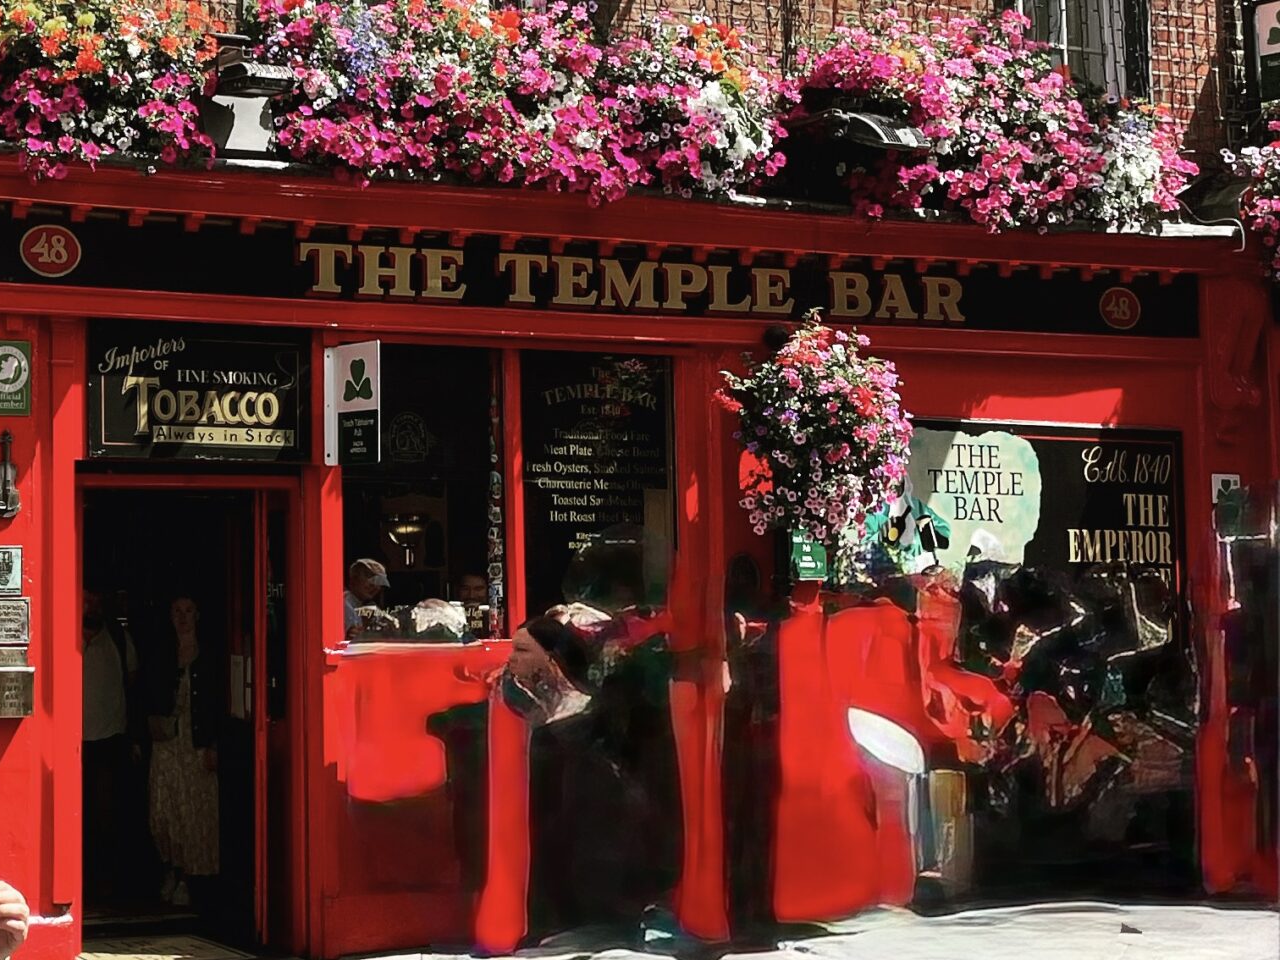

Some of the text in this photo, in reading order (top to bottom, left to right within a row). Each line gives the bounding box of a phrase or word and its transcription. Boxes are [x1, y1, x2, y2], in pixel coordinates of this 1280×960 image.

[30, 232, 68, 264] 48
[298, 241, 966, 323] THE TEMPLE BAR
[1105, 295, 1130, 320] 48
[98, 336, 186, 375] Importers
[153, 359, 169, 371] OF
[177, 369, 278, 387] FINE SMOKING
[121, 375, 280, 436] TOBACCO
[155, 426, 292, 445] Always in Stock
[544, 443, 568, 455] Meat
[553, 461, 592, 475] Oysters,
[951, 443, 1002, 470] THE
[1133, 453, 1171, 484] 1840
[537, 478, 592, 490] Charcuterie
[927, 468, 1025, 496] TEMPLE
[551, 493, 587, 506] Toasted
[953, 496, 1003, 524] BAR
[1122, 493, 1169, 527] THE
[549, 510, 568, 522] Hot
[570, 510, 596, 522] Roast
[1067, 528, 1172, 565] EMPEROR
